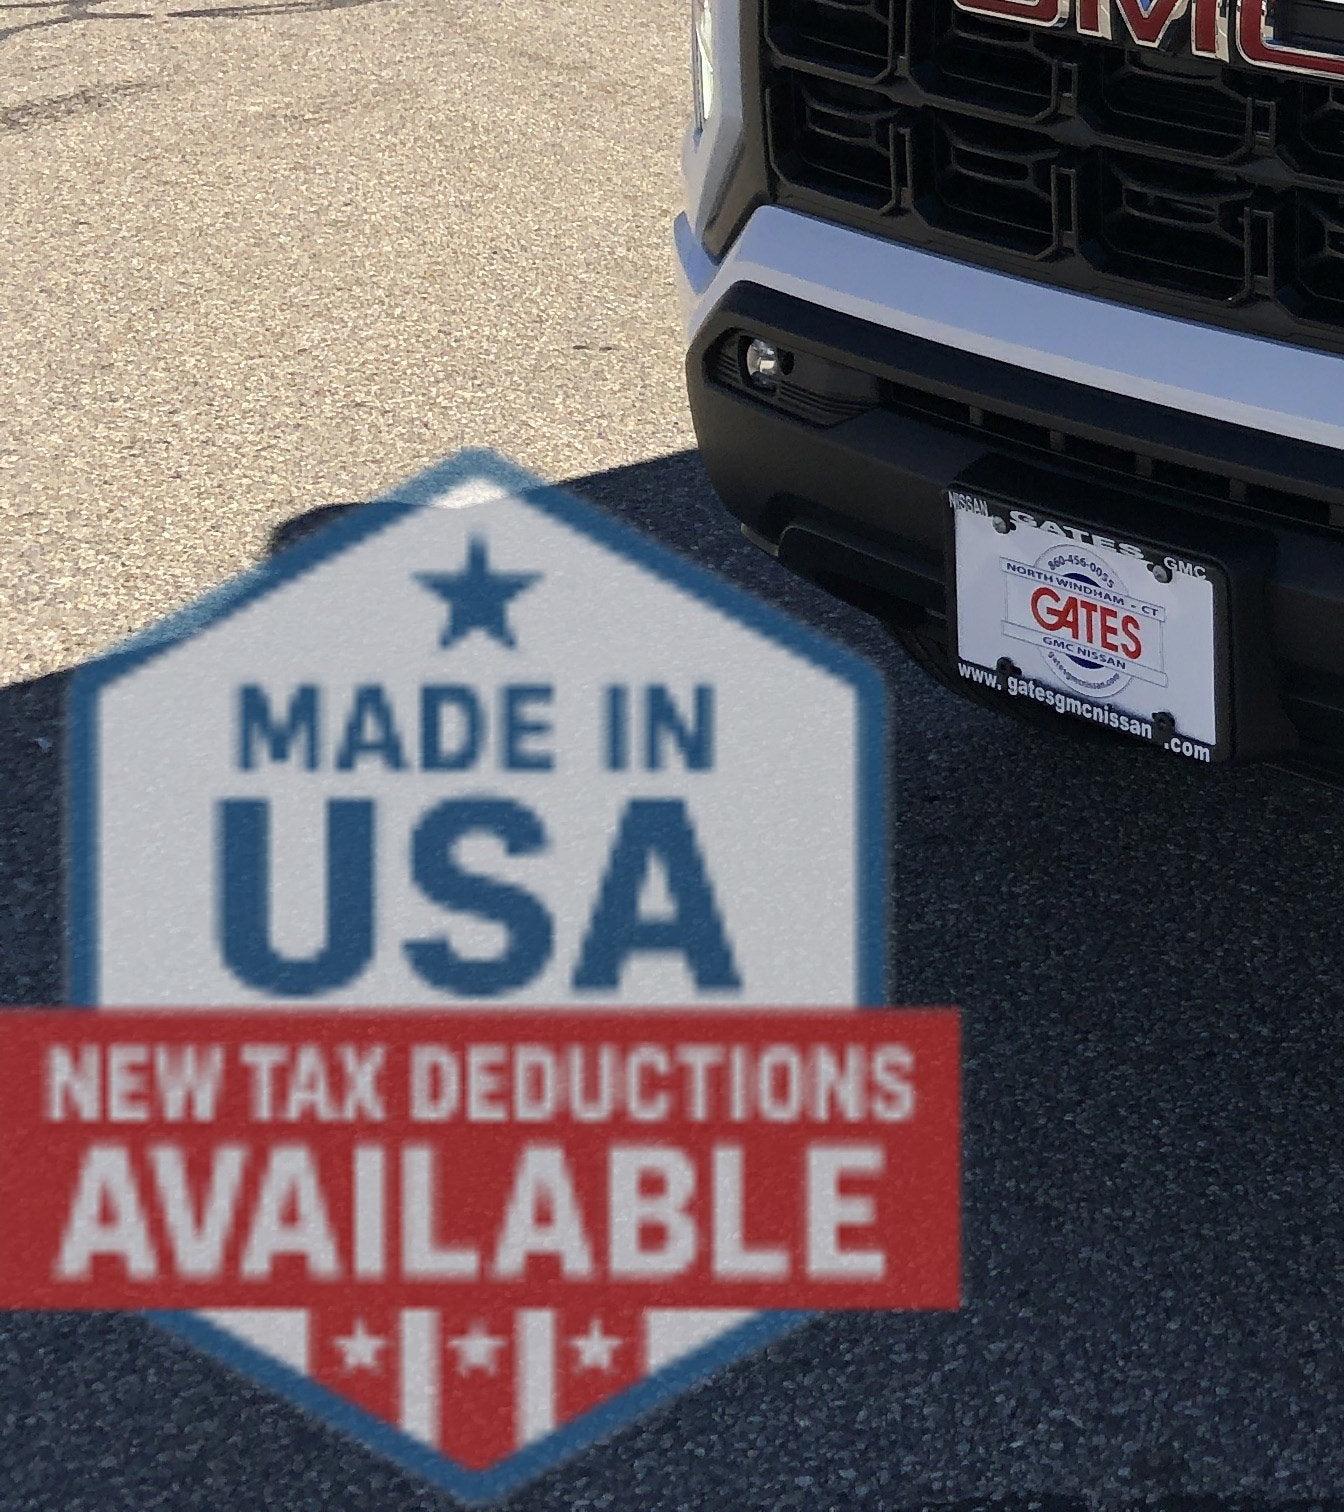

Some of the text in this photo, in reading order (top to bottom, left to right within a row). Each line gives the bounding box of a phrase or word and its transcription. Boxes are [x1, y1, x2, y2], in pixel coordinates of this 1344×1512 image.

[948, 490, 989, 517] NISSAN
[1009, 510, 1144, 560] GATES
[1163, 556, 1207, 580] GMC
[1006, 562, 1054, 583] NORTH
[1055, 577, 1125, 606] WINDHAM
[1141, 605, 1159, 617] CT
[1030, 586, 1142, 660] GATES
[1042, 635, 1126, 670] GMC NISSAN
